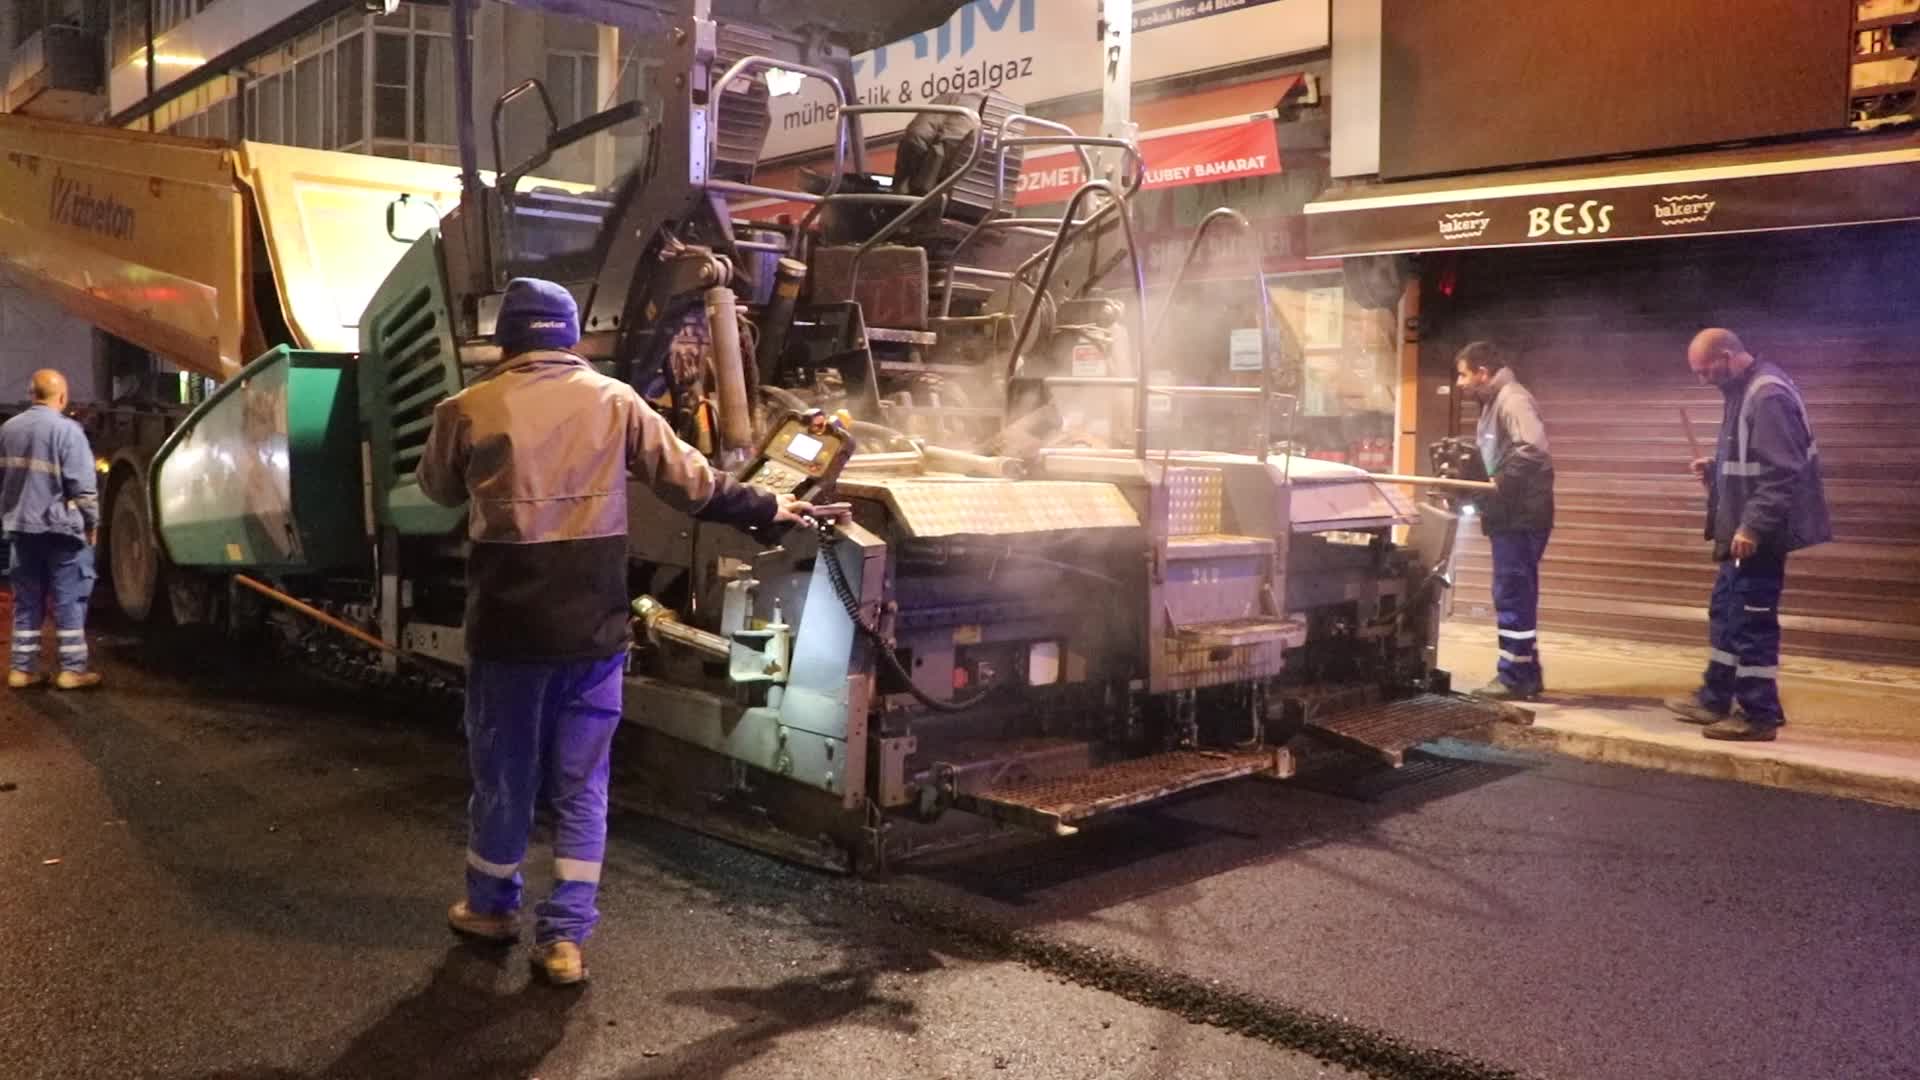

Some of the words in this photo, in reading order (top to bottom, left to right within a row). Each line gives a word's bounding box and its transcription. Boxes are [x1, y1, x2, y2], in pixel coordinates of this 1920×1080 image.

[1176, 6, 1196, 20] No:
[898, 80, 913, 104] &
[921, 57, 1033, 100] doğalgaz
[1194, 155, 1266, 177] BAHARAT
[1654, 200, 1716, 219] bakery
[1438, 216, 1491, 234] bakery
